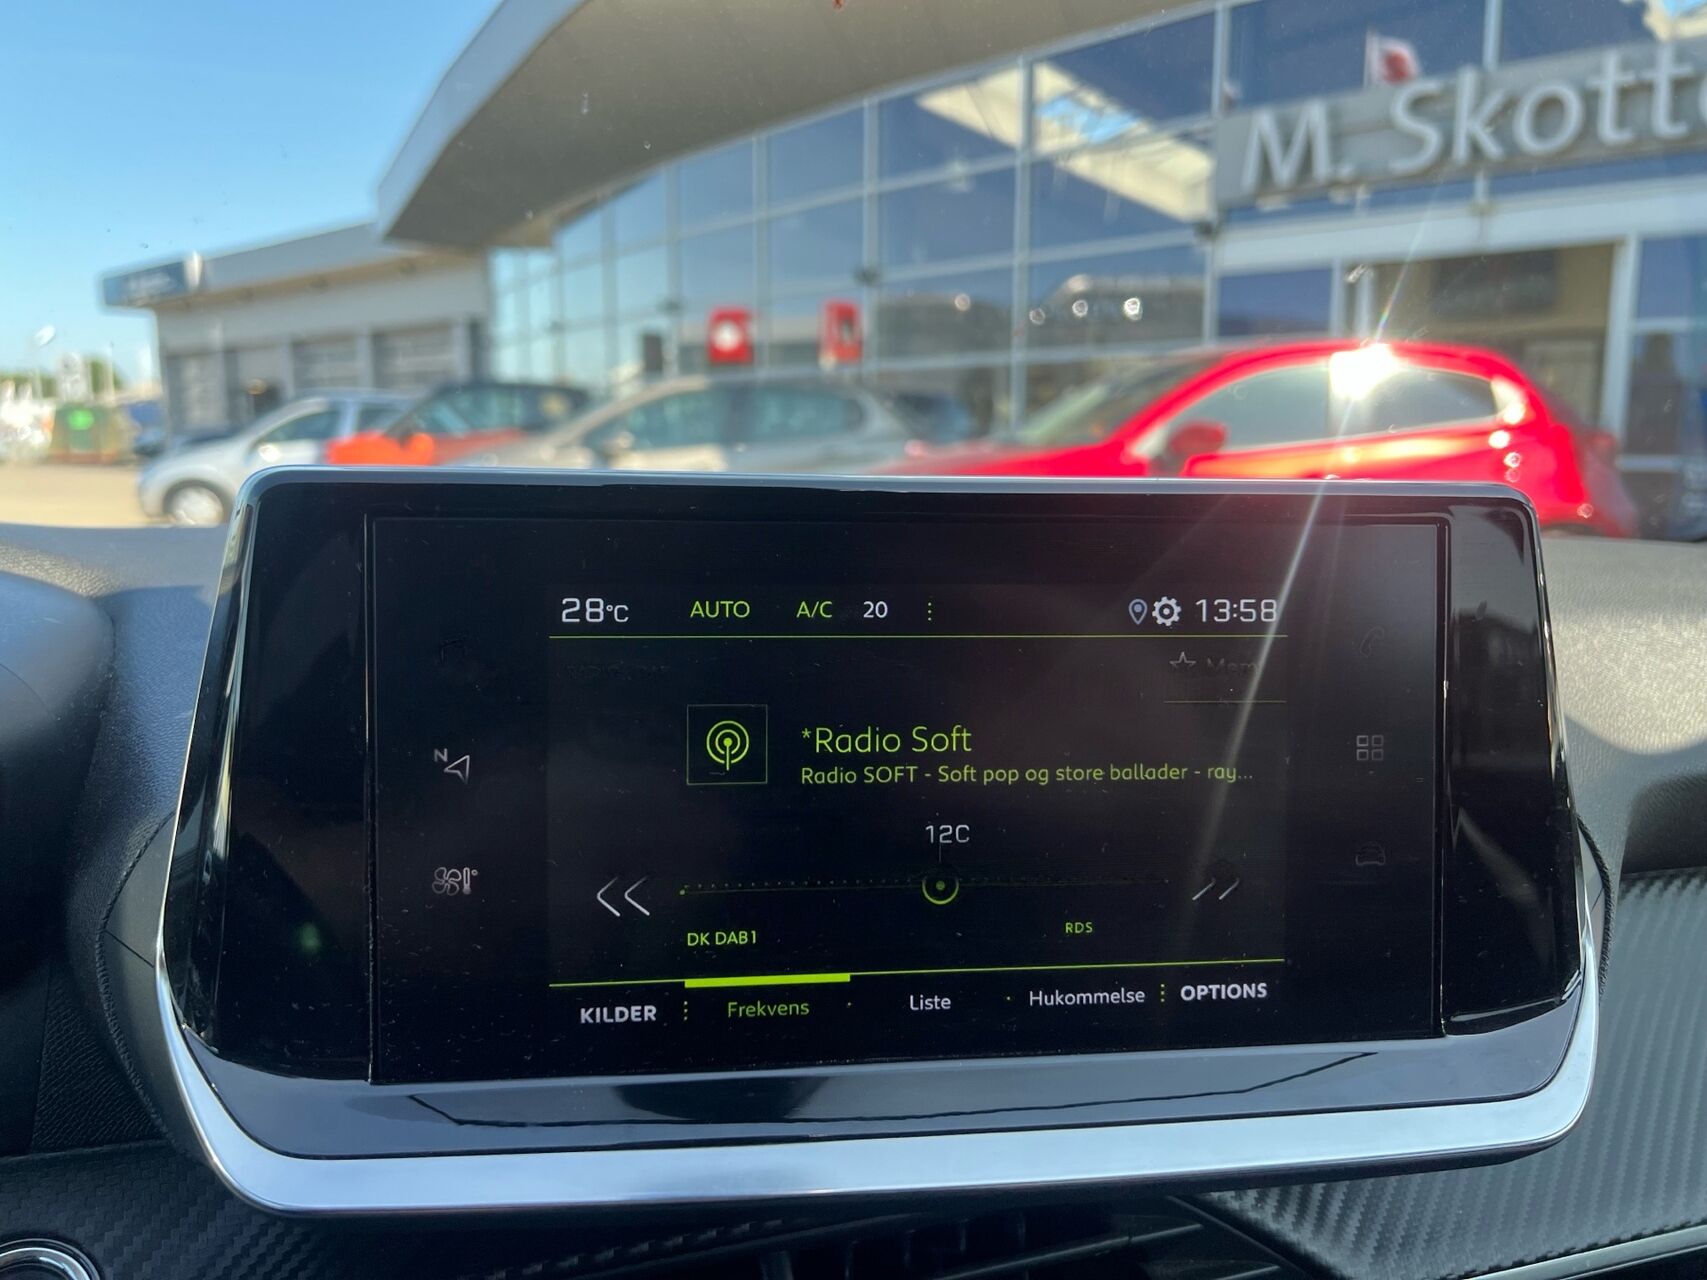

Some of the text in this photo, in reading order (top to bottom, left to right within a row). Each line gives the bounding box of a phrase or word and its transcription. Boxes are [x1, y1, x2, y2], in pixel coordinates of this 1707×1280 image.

[1241, 42, 1707, 194] M. Skott
[689, 600, 751, 618] AUTO
[796, 600, 833, 619] A/C
[863, 600, 889, 618] 20
[1195, 598, 1278, 622] 13:58
[911, 725, 972, 752] Soft
[801, 767, 857, 785] Radio
[863, 766, 919, 784] SOFT
[938, 765, 977, 783] Soft
[983, 769, 1020, 786] pop
[1025, 769, 1049, 786] og
[1056, 765, 1106, 781] store
[1110, 763, 1188, 781] ballader
[925, 824, 970, 844] 12C
[1065, 922, 1093, 934] RDS
[687, 931, 757, 946] DK DAB1
[1029, 987, 1146, 1007] Hukommelse
[1180, 983, 1268, 1001] OPTIONS
[727, 1001, 810, 1018] Frekvens
[909, 994, 952, 1011] Liste
[580, 1005, 657, 1024] KILDER
